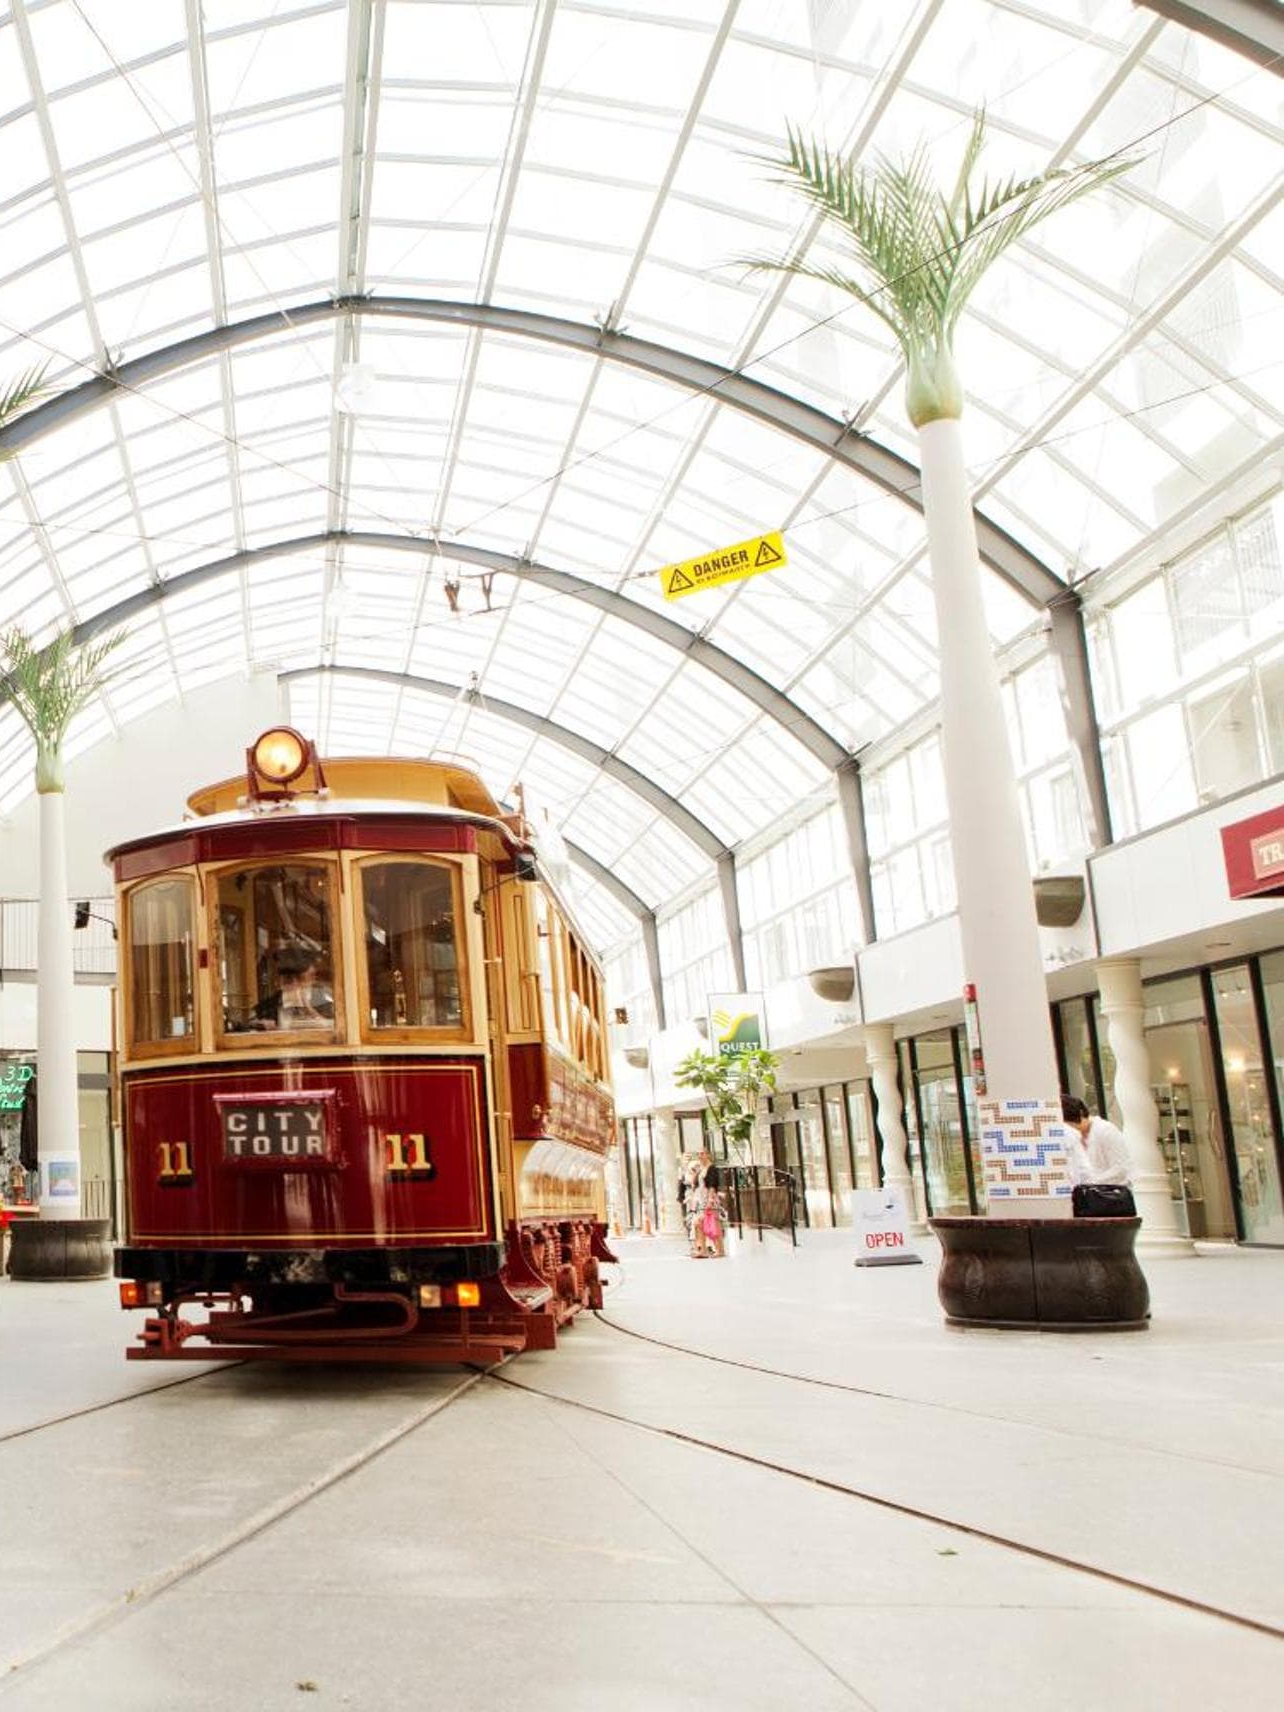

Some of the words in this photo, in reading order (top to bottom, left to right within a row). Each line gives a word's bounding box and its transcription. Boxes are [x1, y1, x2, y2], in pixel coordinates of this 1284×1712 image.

[693, 549, 749, 577] DANGER
[720, 1042, 759, 1053] QUEST
[4, 1065, 34, 1081] 3D
[227, 1112, 323, 1132] CITY
[228, 1135, 323, 1155] TOUR
[385, 1133, 432, 1171] 11
[159, 1141, 193, 1177] 11
[865, 1232, 904, 1249] OPEN
